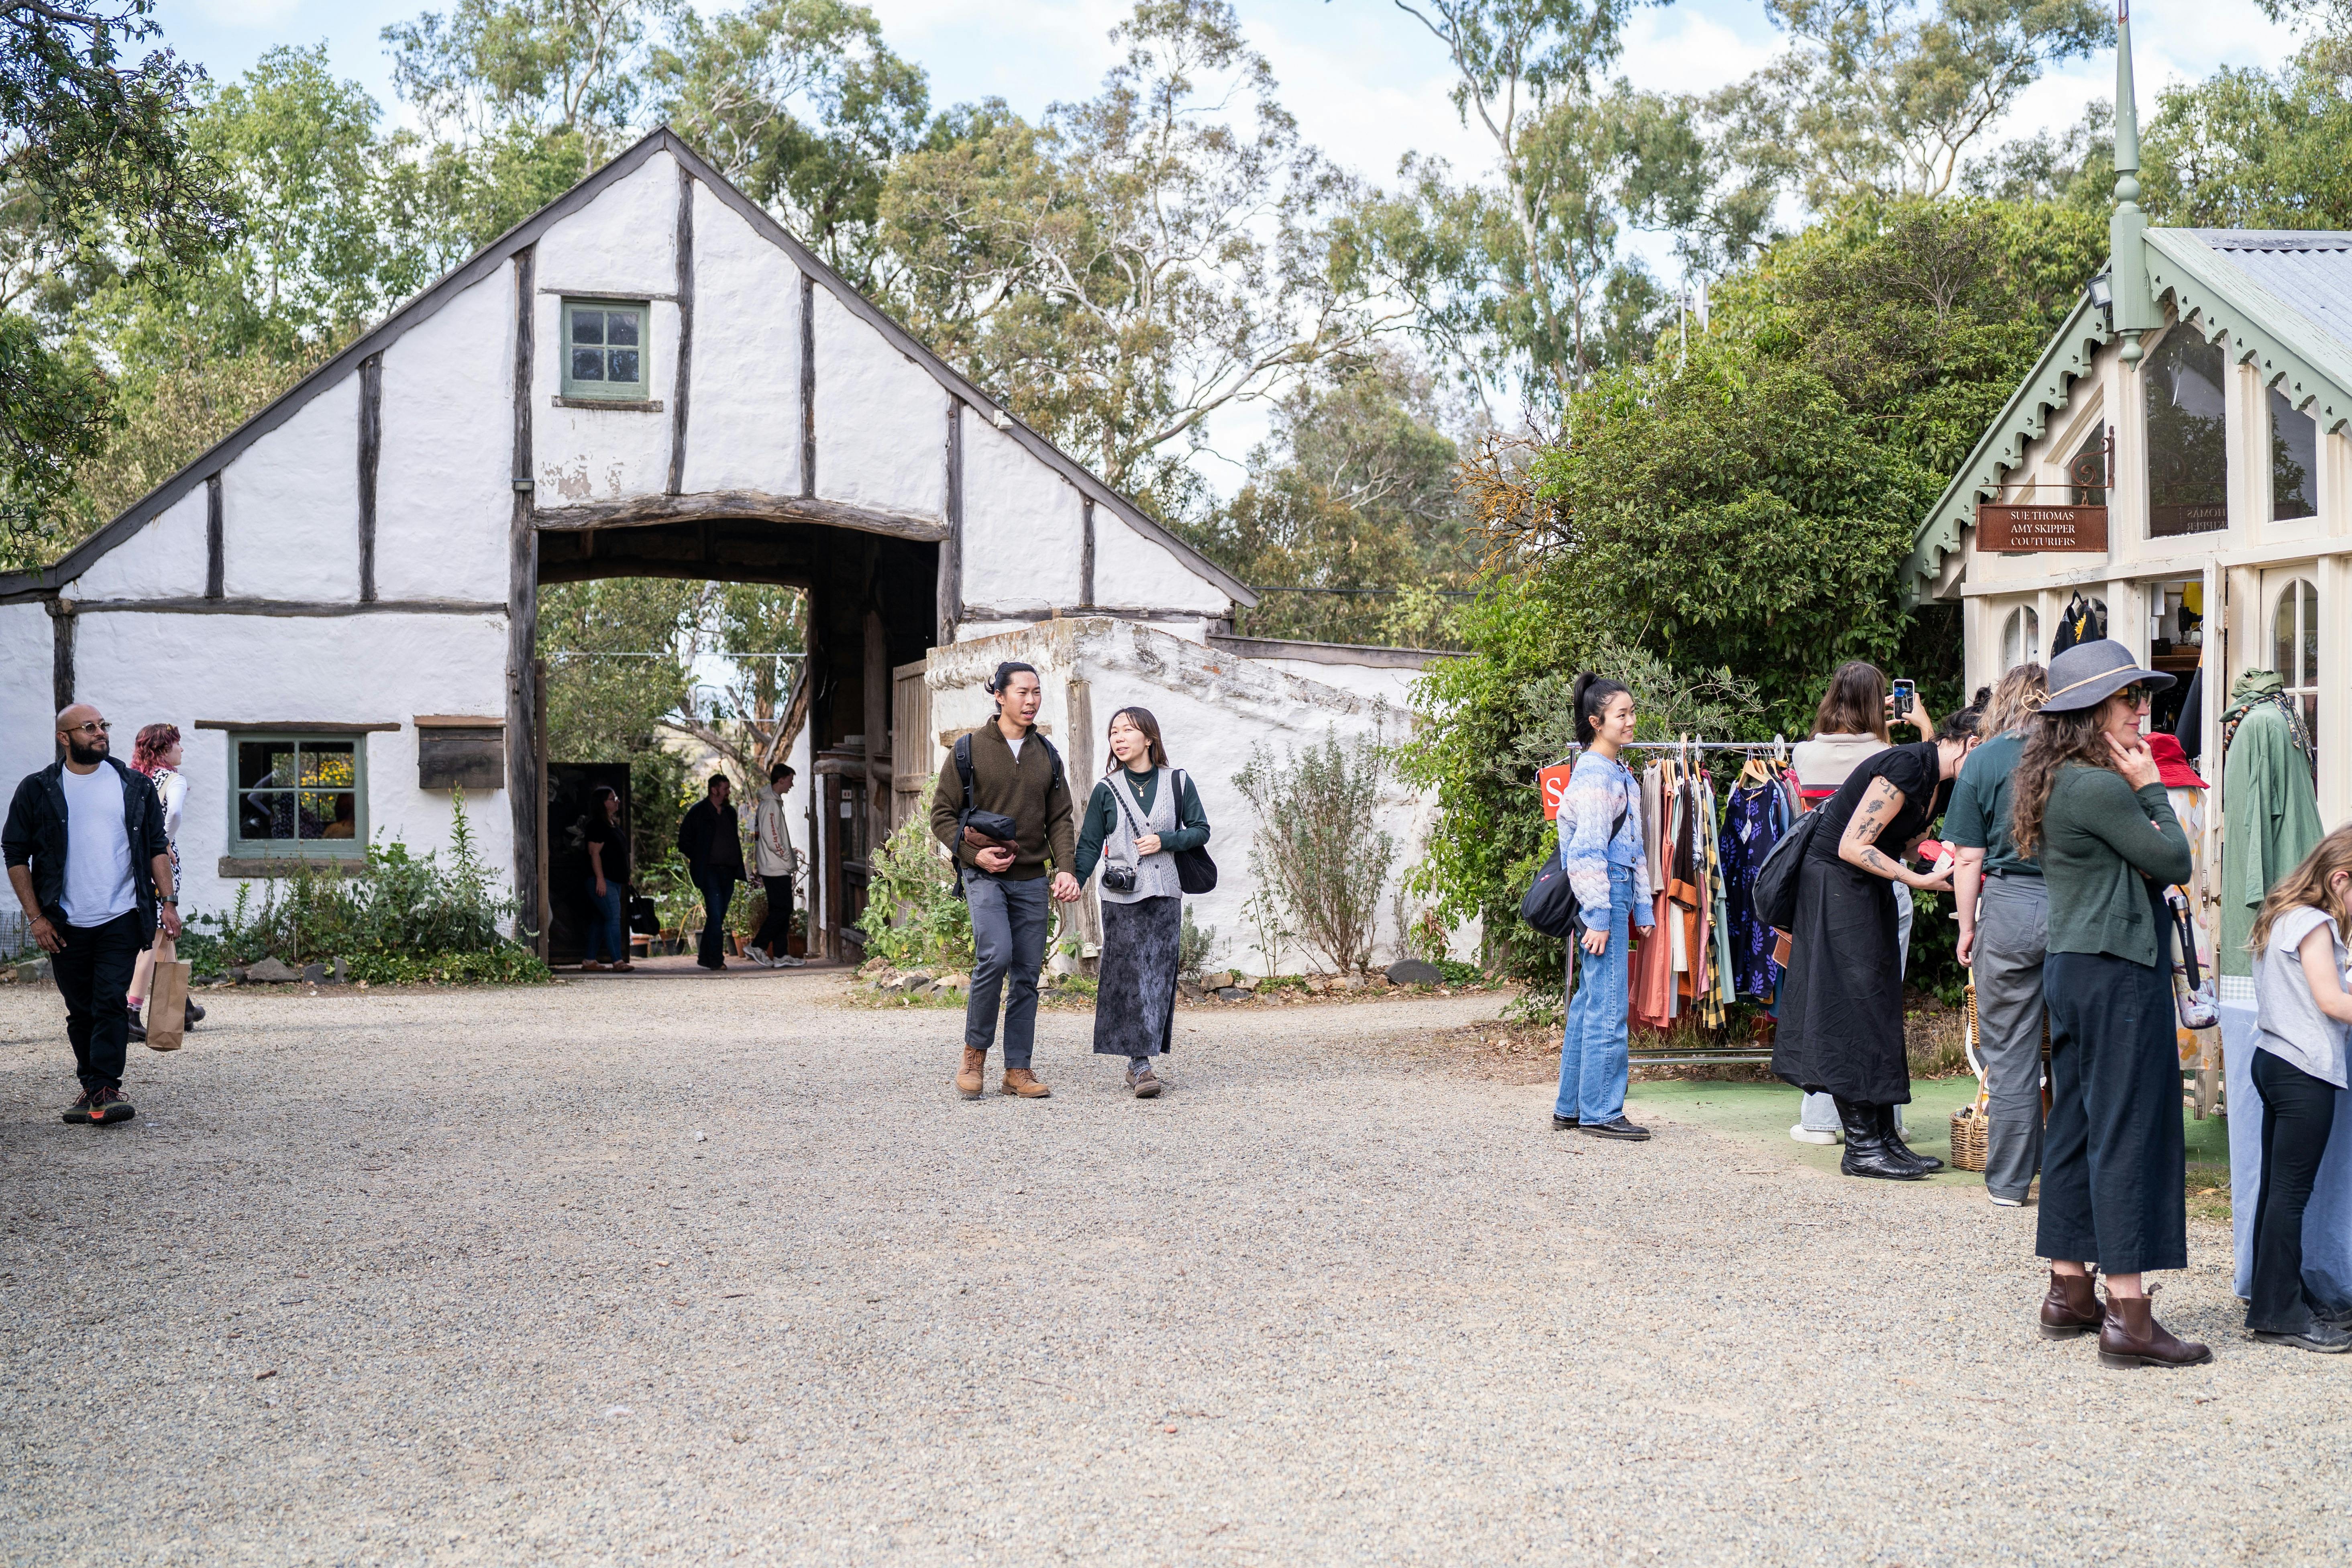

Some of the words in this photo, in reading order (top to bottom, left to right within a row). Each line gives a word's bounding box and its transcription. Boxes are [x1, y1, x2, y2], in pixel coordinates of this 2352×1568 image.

[2011, 511, 2030, 520] SUE
[2032, 511, 2074, 520] THOMAS
[2011, 524, 2032, 533] AMY
[2034, 524, 2075, 533] SKIPPER
[2011, 537, 2075, 546] COUTURIERS
[1546, 777, 1563, 807] S
